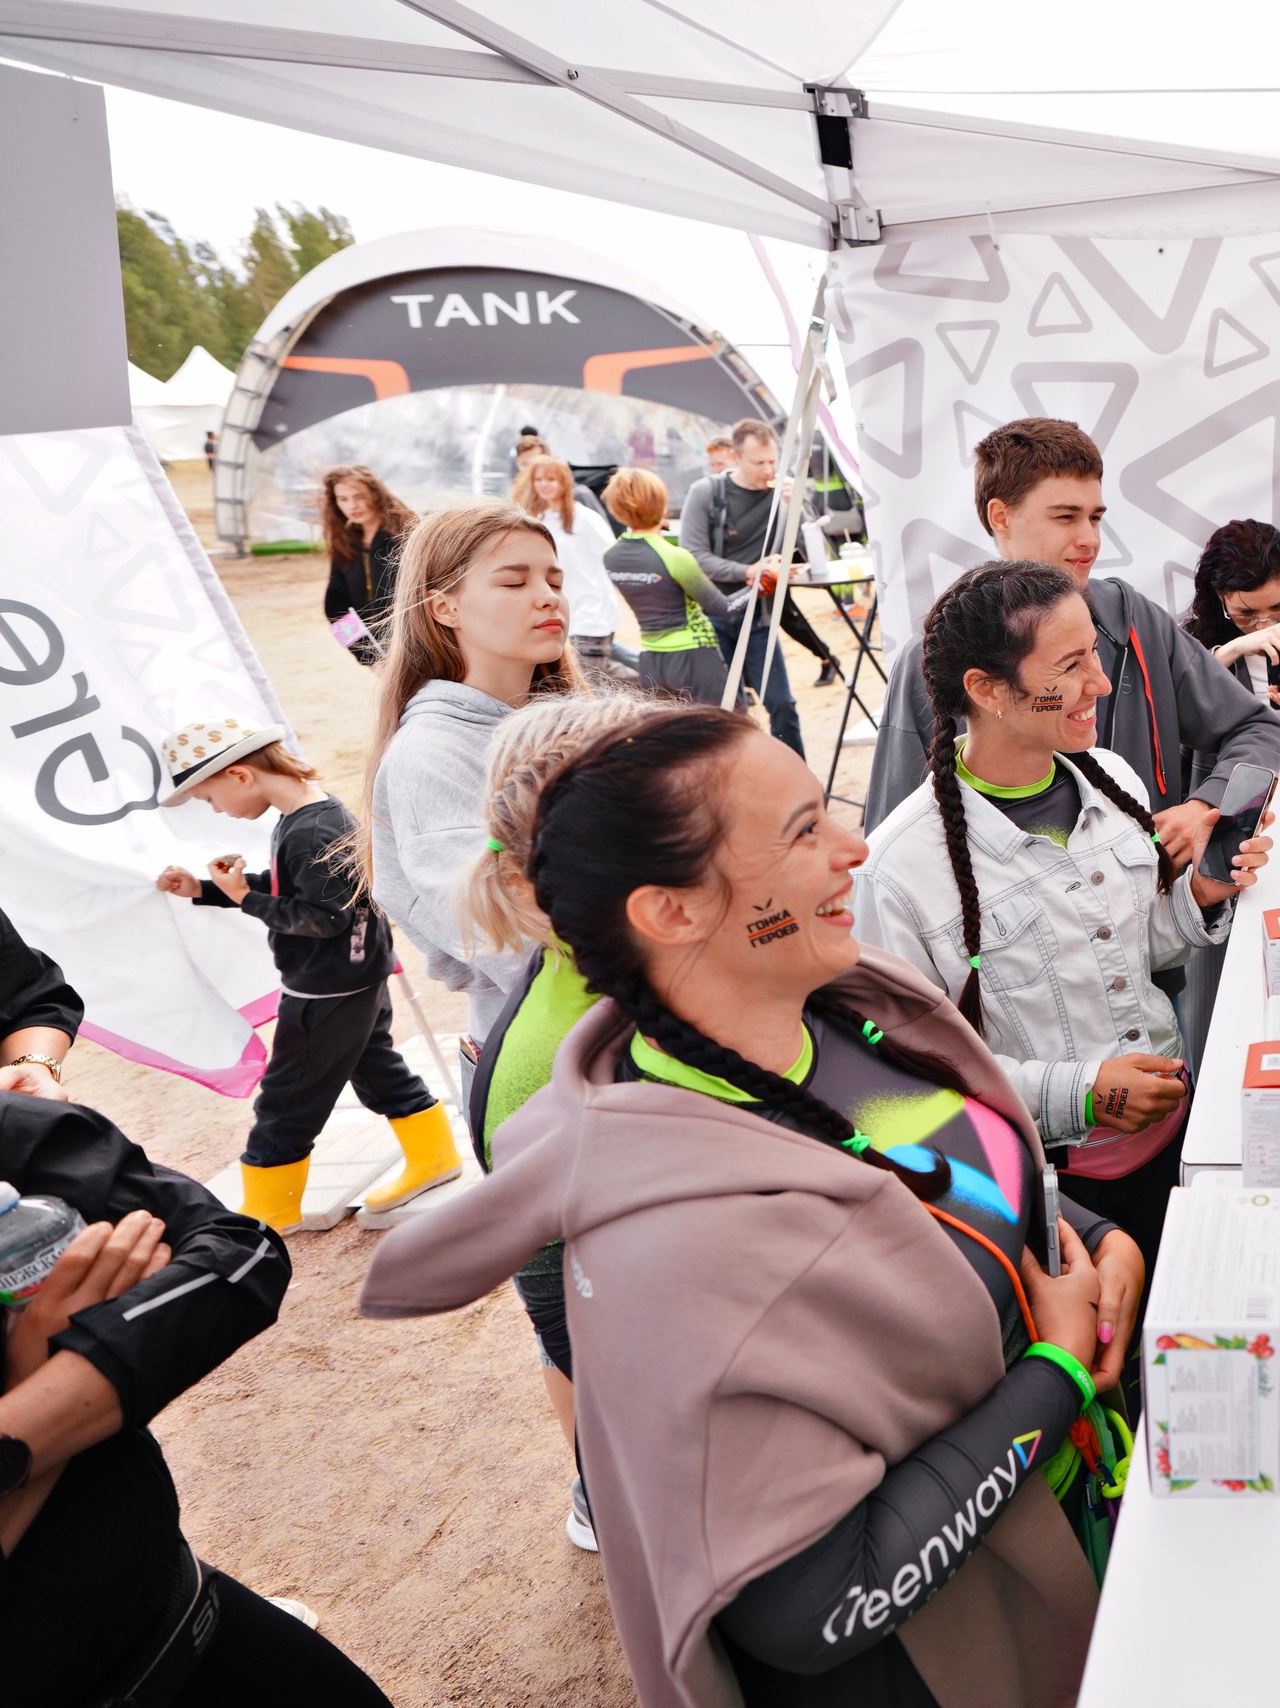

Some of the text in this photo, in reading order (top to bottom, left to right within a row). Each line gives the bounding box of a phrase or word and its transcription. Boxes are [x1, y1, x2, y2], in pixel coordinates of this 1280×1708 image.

[390, 290, 581, 328] TANK
[1031, 704, 1063, 712] ГЕРОЕВ
[1034, 694, 1063, 703] ГОНКА
[746, 909, 792, 934] ГОНКА
[750, 922, 799, 948] ГЕРОЕВ
[1105, 1087, 1118, 1115] ГОНКА
[1115, 1087, 1129, 1120] ГЕРОЕВ
